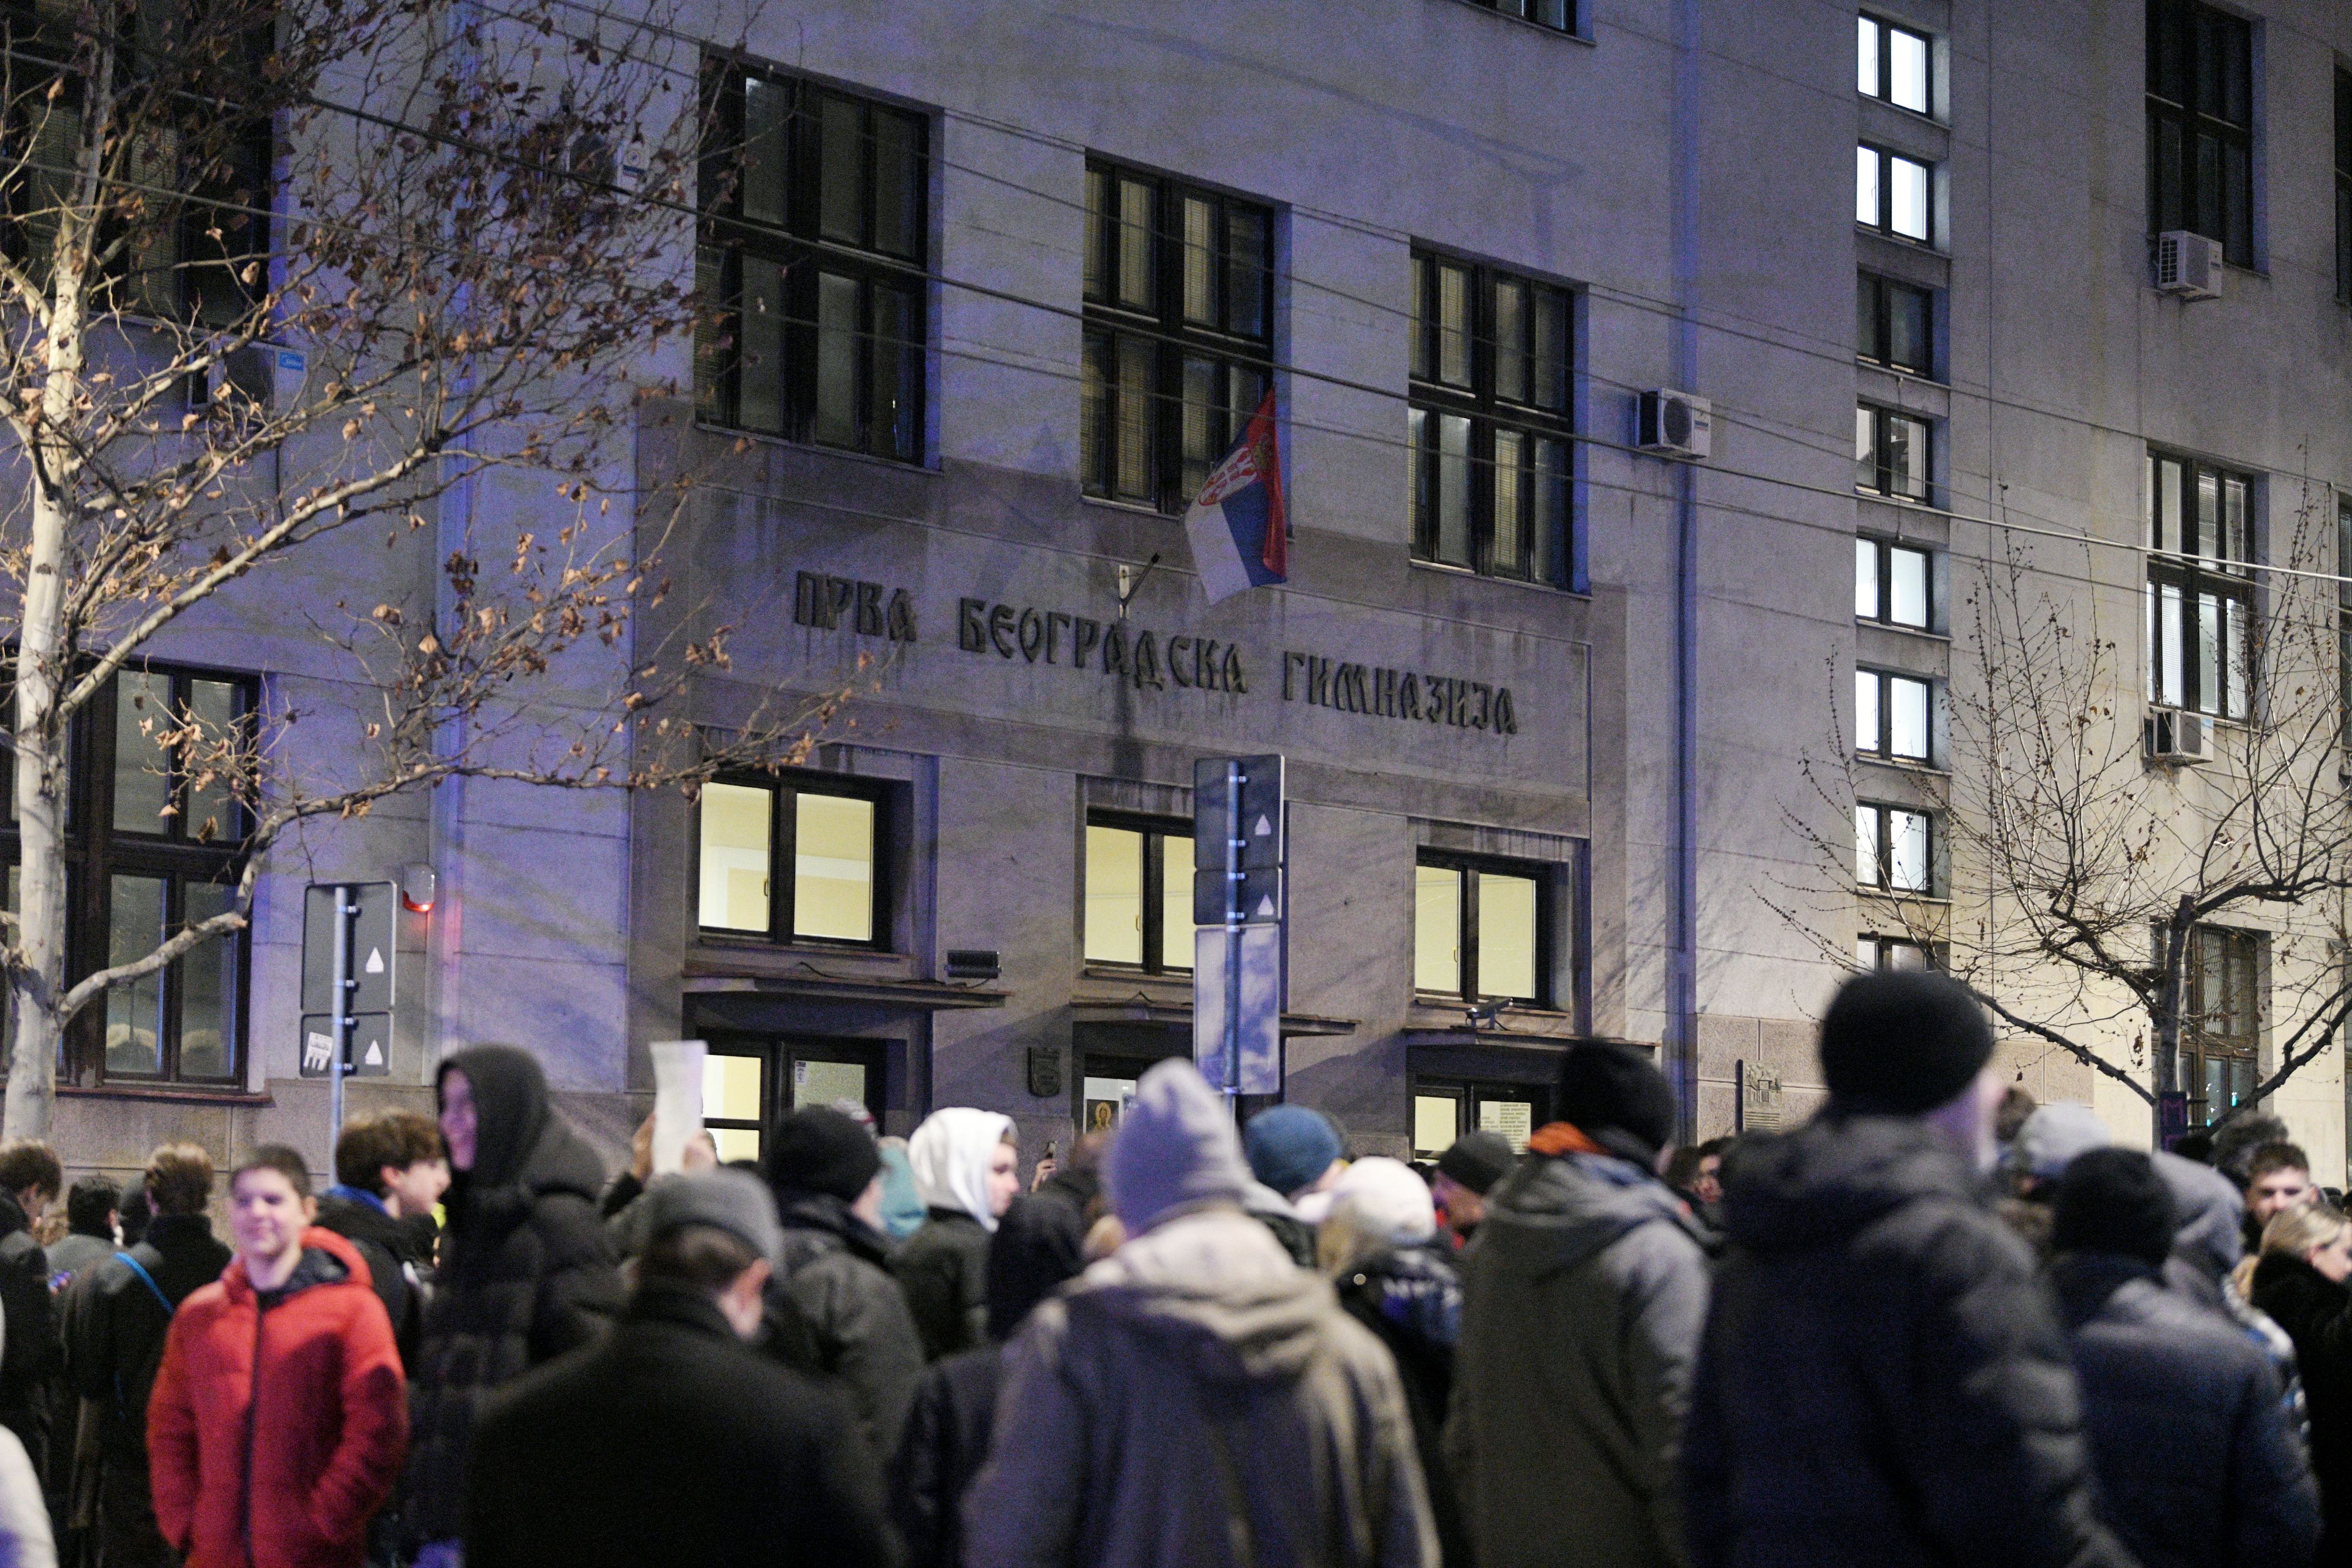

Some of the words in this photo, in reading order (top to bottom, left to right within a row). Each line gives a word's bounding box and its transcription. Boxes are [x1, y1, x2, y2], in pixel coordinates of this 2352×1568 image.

[795, 570, 916, 641] ПРВА
[960, 597, 1248, 693] БЕОГРАДСКА
[1284, 651, 1517, 734] ГИМНАЗИЈА
